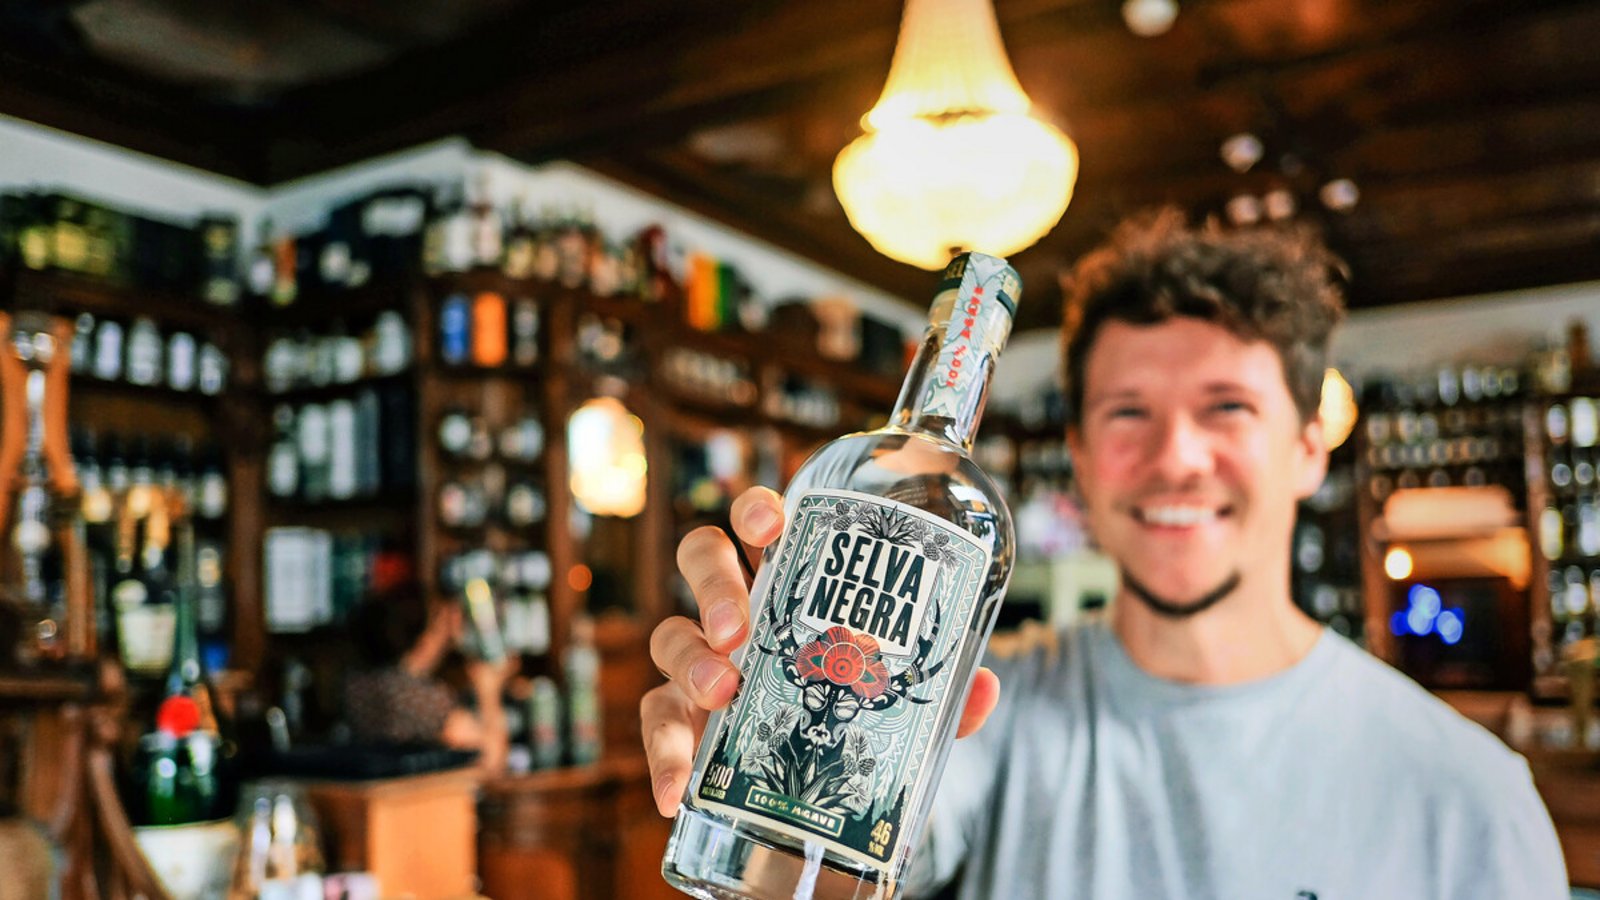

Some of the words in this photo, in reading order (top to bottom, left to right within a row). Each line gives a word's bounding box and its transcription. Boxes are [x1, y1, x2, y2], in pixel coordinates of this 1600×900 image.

[946, 345, 967, 387] 100%
[960, 286, 984, 340] AGAVE
[824, 532, 925, 603] SELVA
[807, 576, 914, 647] NEGRA
[753, 793, 789, 811] 100%
[791, 805, 836, 829] AGAVE
[869, 819, 892, 846] 46
